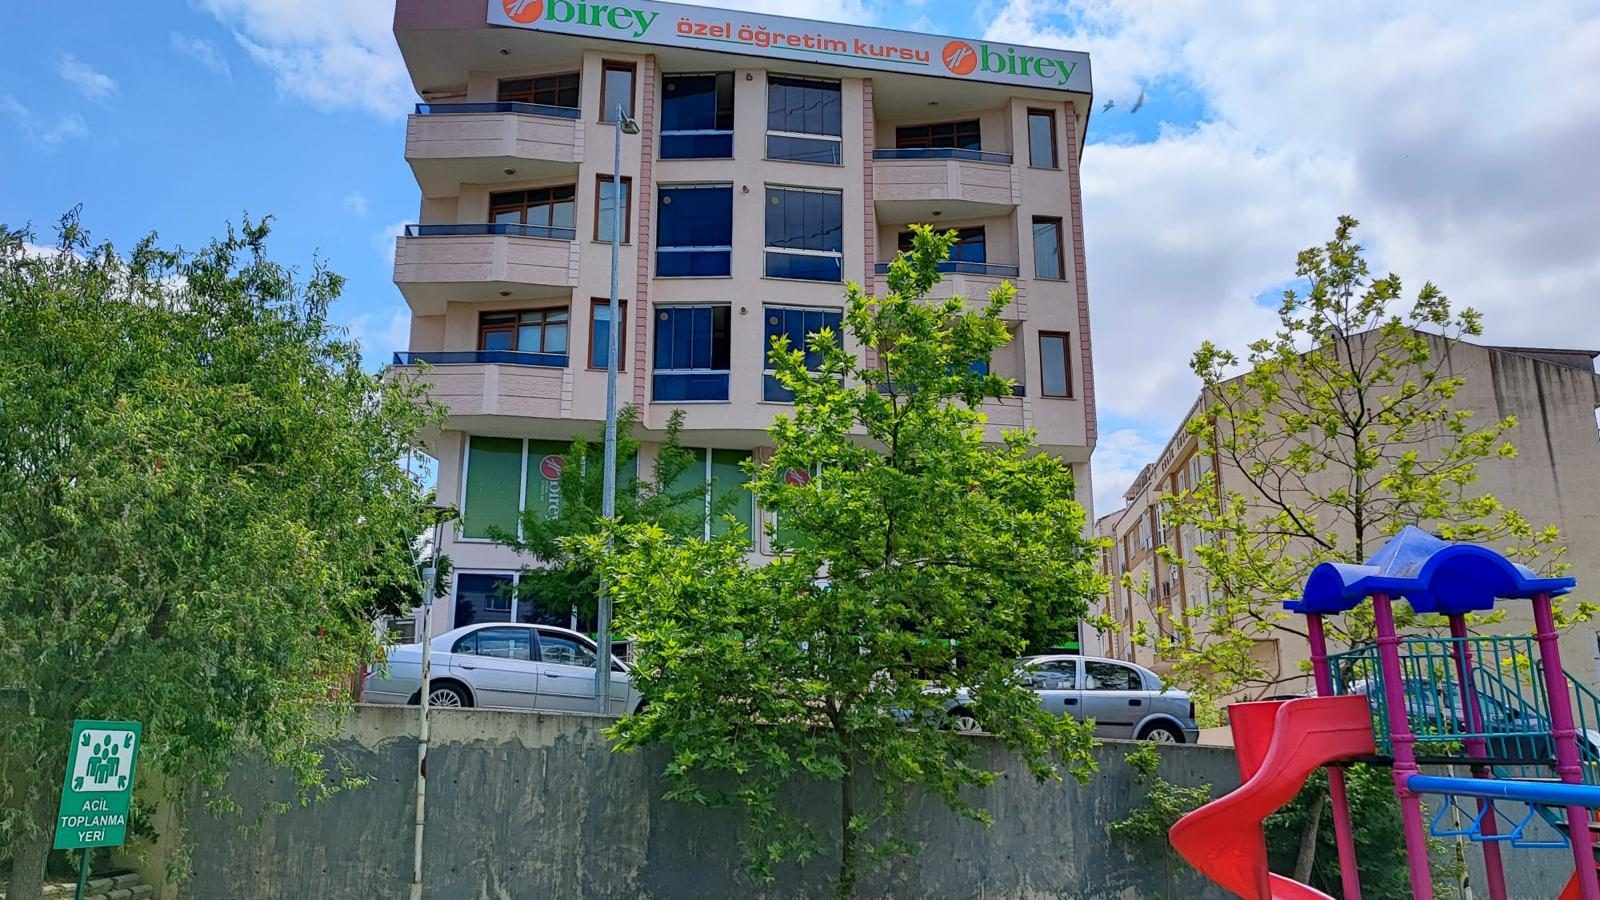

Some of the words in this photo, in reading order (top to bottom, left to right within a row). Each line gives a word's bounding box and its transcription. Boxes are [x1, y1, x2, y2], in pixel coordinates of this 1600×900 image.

[544, 0, 660, 37] birey
[676, 17, 731, 39] özel
[738, 24, 848, 53] öğretim
[853, 38, 930, 63] kursu
[980, 44, 1078, 86] birey
[82, 797, 109, 811] ACİL
[61, 814, 125, 828] TOPLANMA
[78, 827, 105, 842] YERİ
